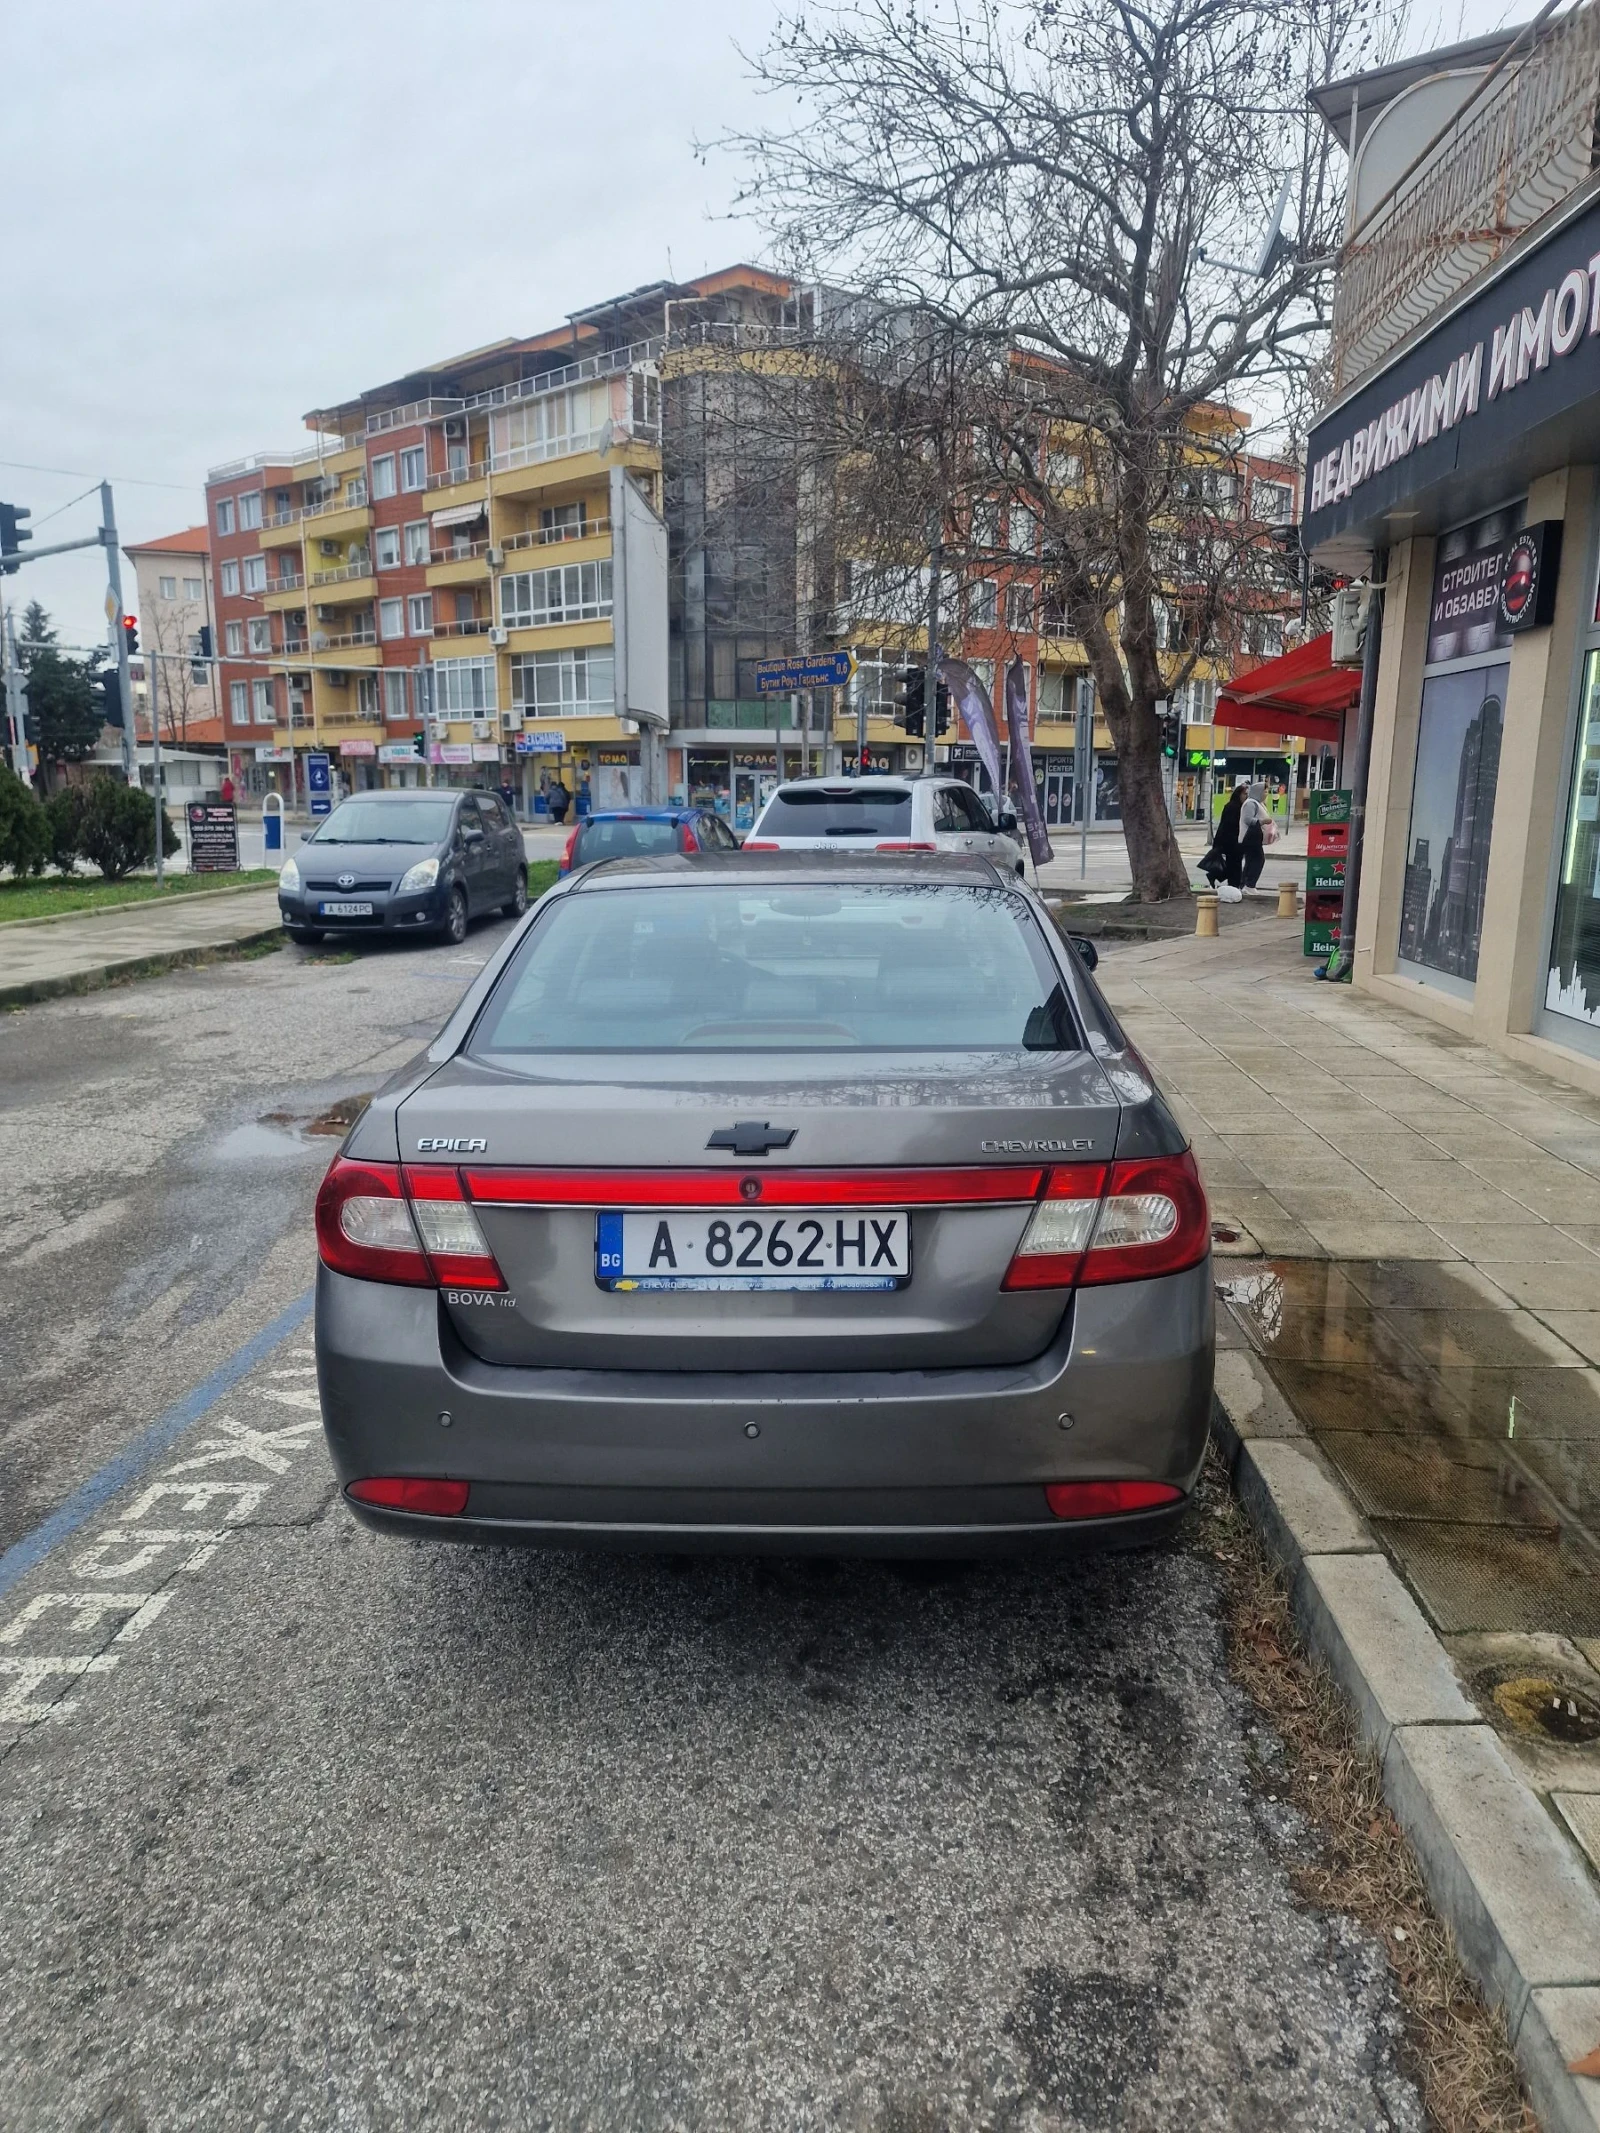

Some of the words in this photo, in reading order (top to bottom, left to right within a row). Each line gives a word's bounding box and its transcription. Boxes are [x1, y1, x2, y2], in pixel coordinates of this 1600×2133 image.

[1310, 342, 1484, 513] НЕДВИЖИМИ
[1501, 583, 1536, 624] CONSTRUCTION
[1434, 602, 1443, 622] И
[757, 661, 785, 675] Boutique
[787, 659, 804, 670] Rose
[805, 656, 836, 668] Gardens
[761, 677, 780, 691] Бутик
[781, 675, 797, 688] Роуз
[798, 673, 829, 686] Гардънс
[527, 731, 563, 745] EXCHANGE
[1048, 756, 1073, 764] SPORTS
[1048, 765, 1073, 773] CENTER
[1315, 877, 1345, 887] Heine
[337, 905, 358, 913] 6124
[359, 905, 370, 913] PC
[1312, 942, 1336, 952] Hein
[417, 1138, 487, 1153] EPICA
[981, 1138, 1095, 1154] CHEVROLET
[649, 1221, 677, 1268] A
[706, 1220, 824, 1268] 8262
[836, 1220, 898, 1268] HX
[601, 1254, 621, 1268] BG
[448, 1291, 495, 1307] BOVA
